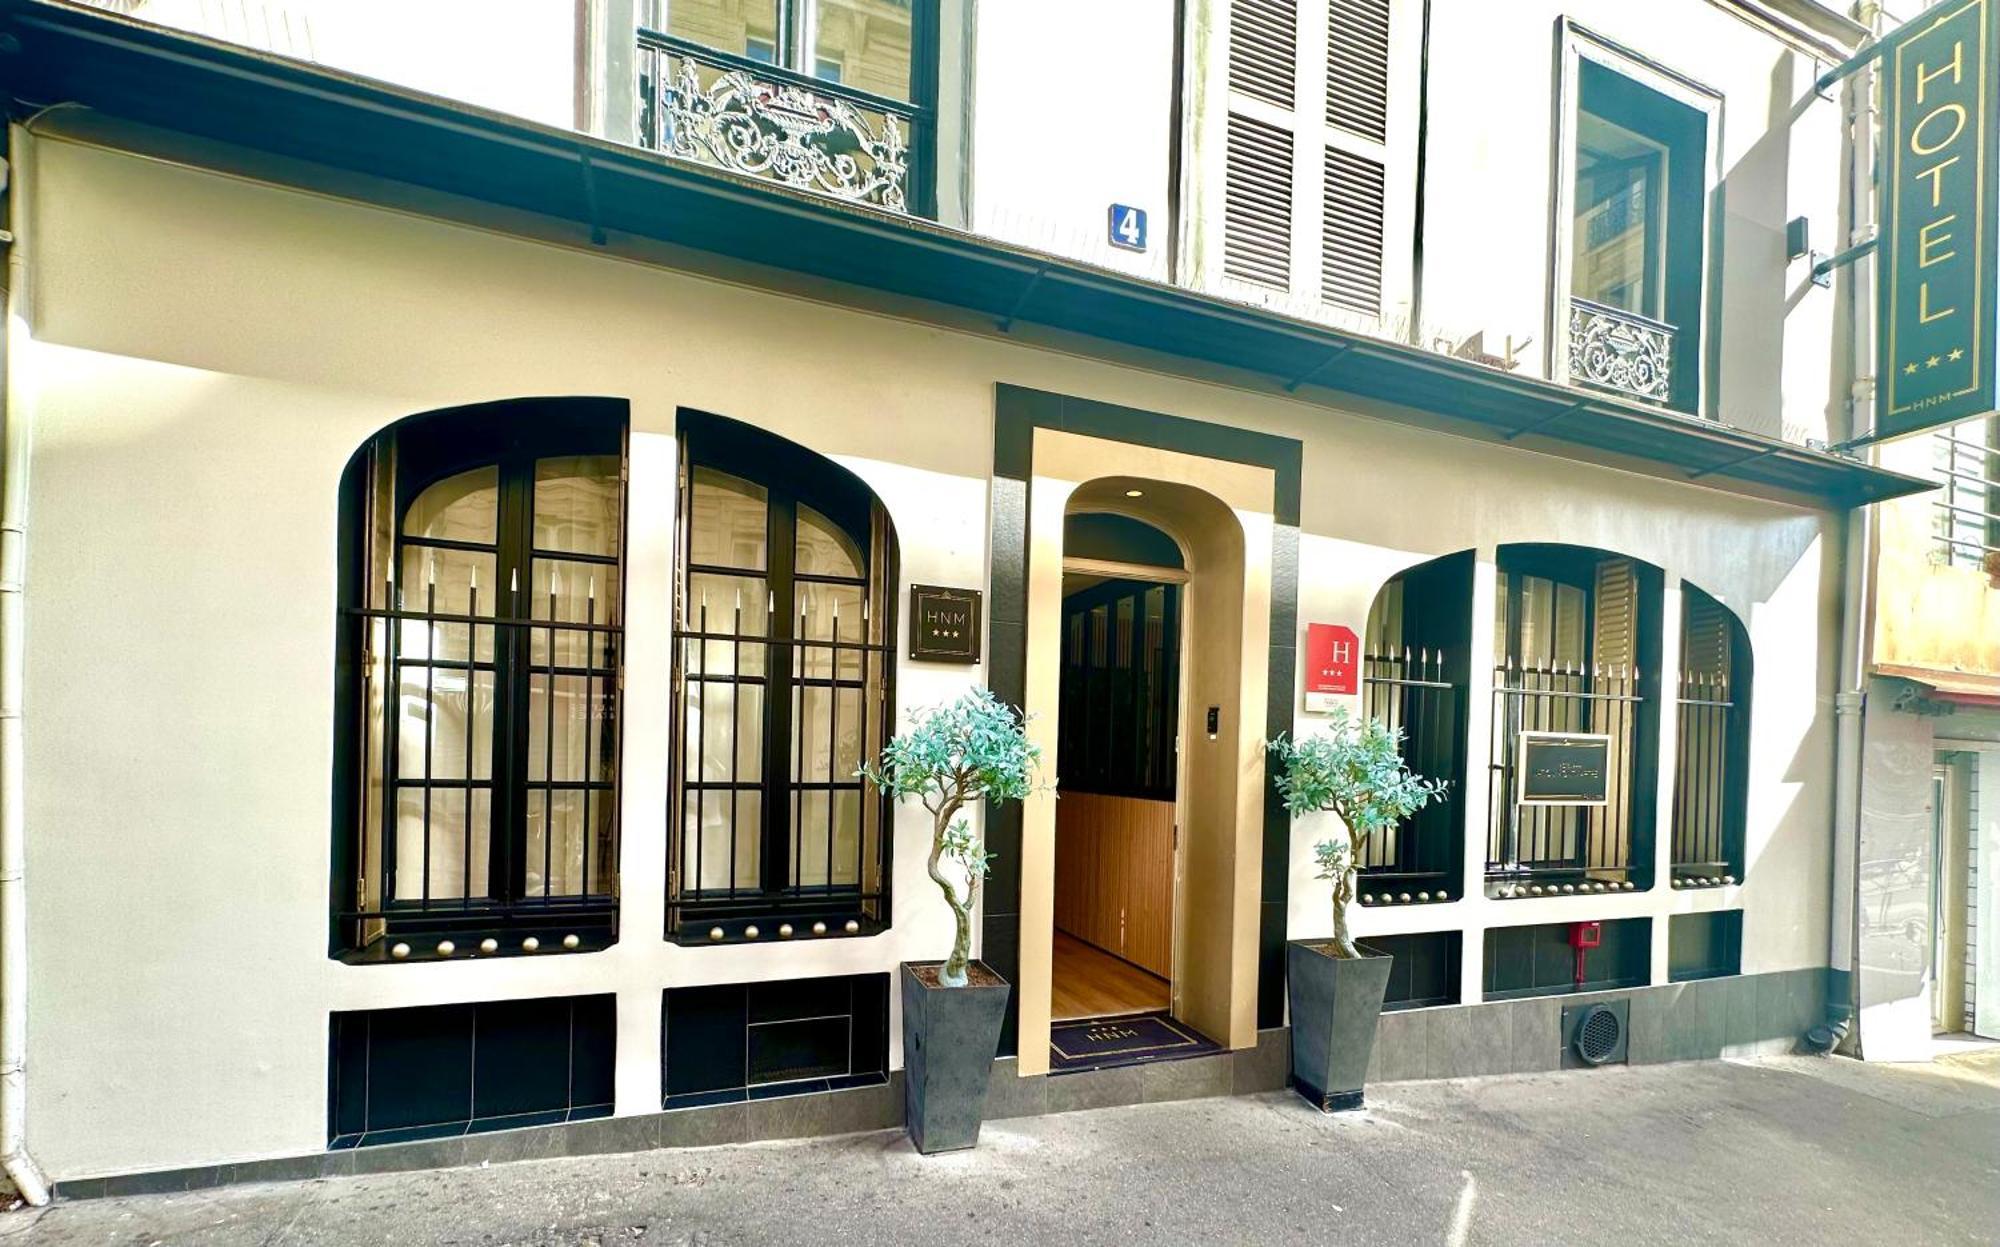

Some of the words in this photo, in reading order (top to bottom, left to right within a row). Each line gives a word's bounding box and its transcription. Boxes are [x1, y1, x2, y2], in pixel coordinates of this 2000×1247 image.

[1911, 41, 1967, 325] HOTEL
[1119, 208, 1140, 245] 4
[1912, 392, 1954, 412] HNM
[927, 610, 966, 625] HNM
[1332, 640, 1351, 664] H
[1086, 1029, 1138, 1042] HNM
